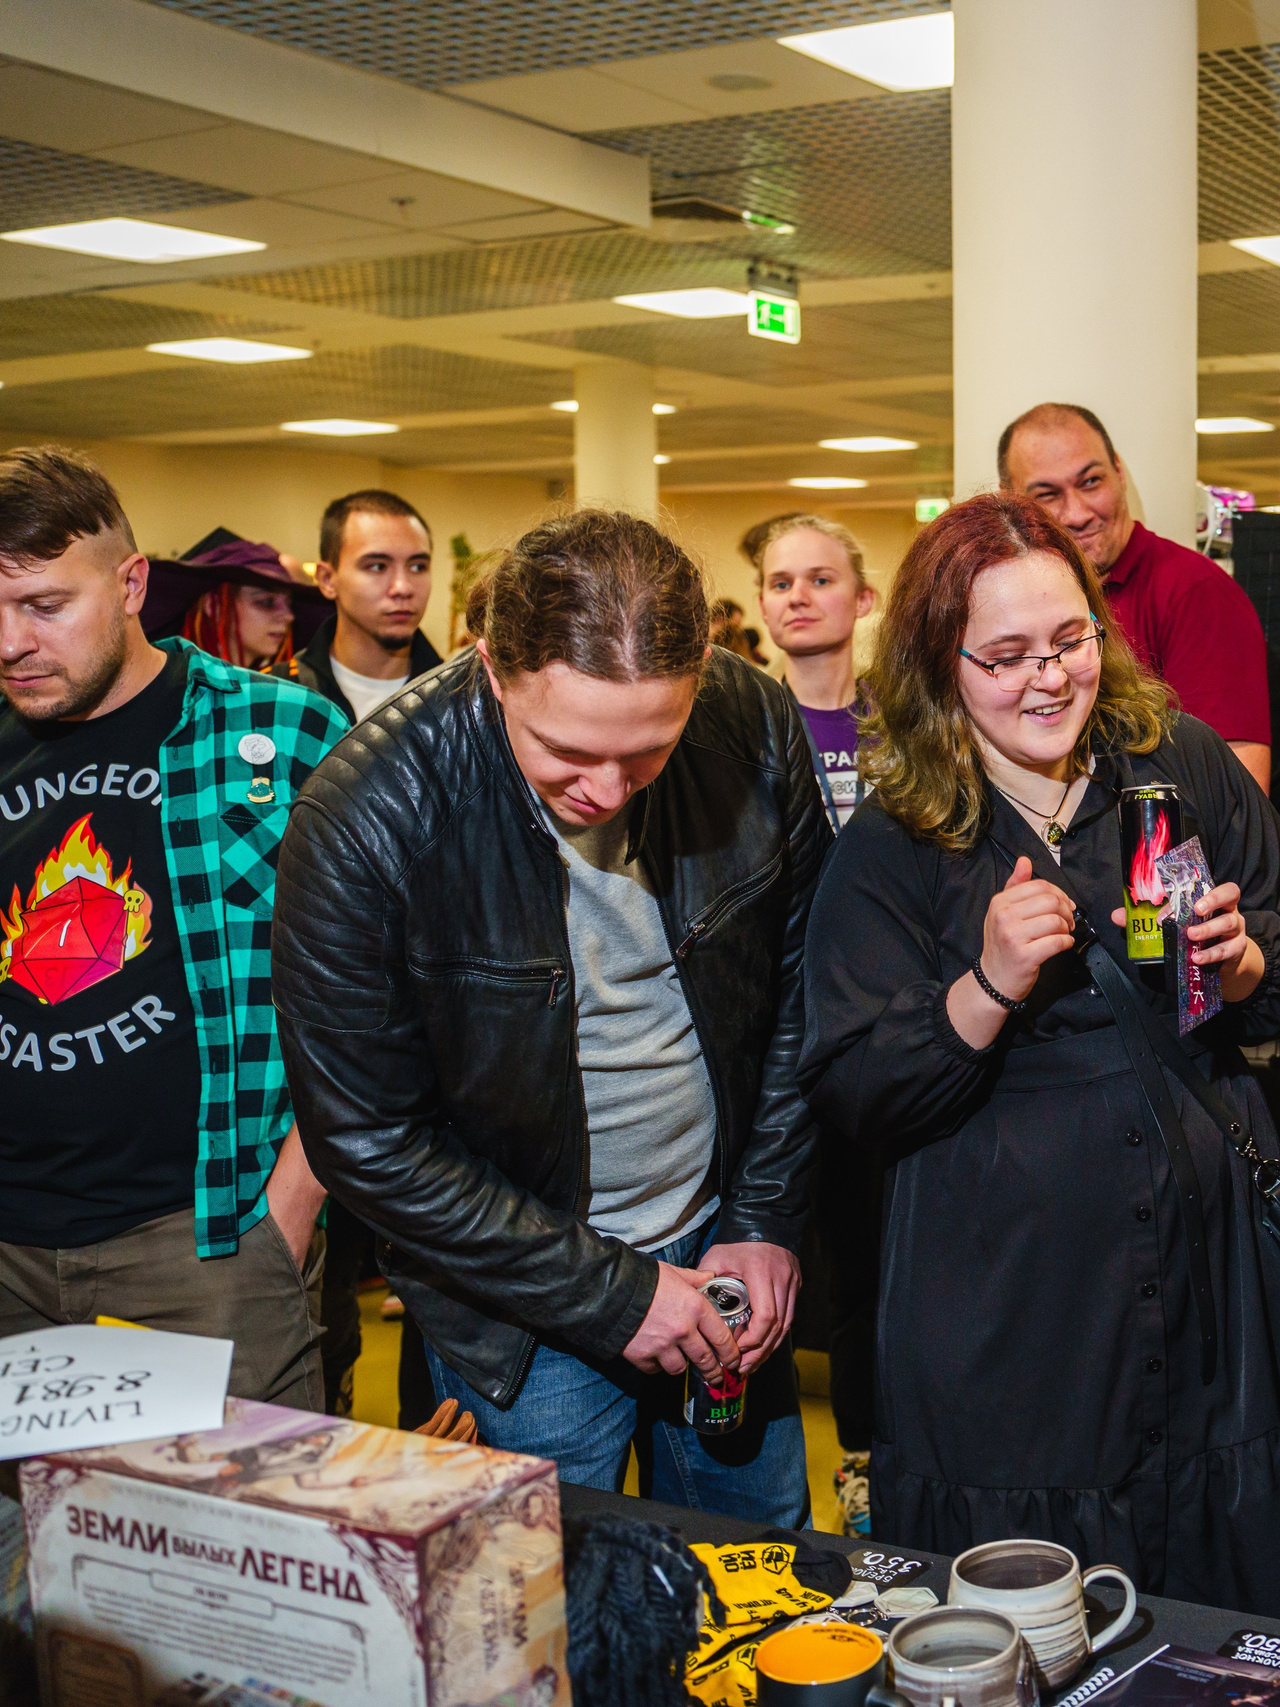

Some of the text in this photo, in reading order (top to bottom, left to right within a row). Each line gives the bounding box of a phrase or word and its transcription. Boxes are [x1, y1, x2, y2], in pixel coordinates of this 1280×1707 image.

[818, 750, 860, 768] РА
[0, 763, 162, 821] UNGEO
[115, 1370, 151, 1392] 8
[1, 1400, 142, 1436] LIVING
[66, 1505, 169, 1559] ЗЕМЛИ
[239, 1546, 370, 1605] ЛЕГЕНД
